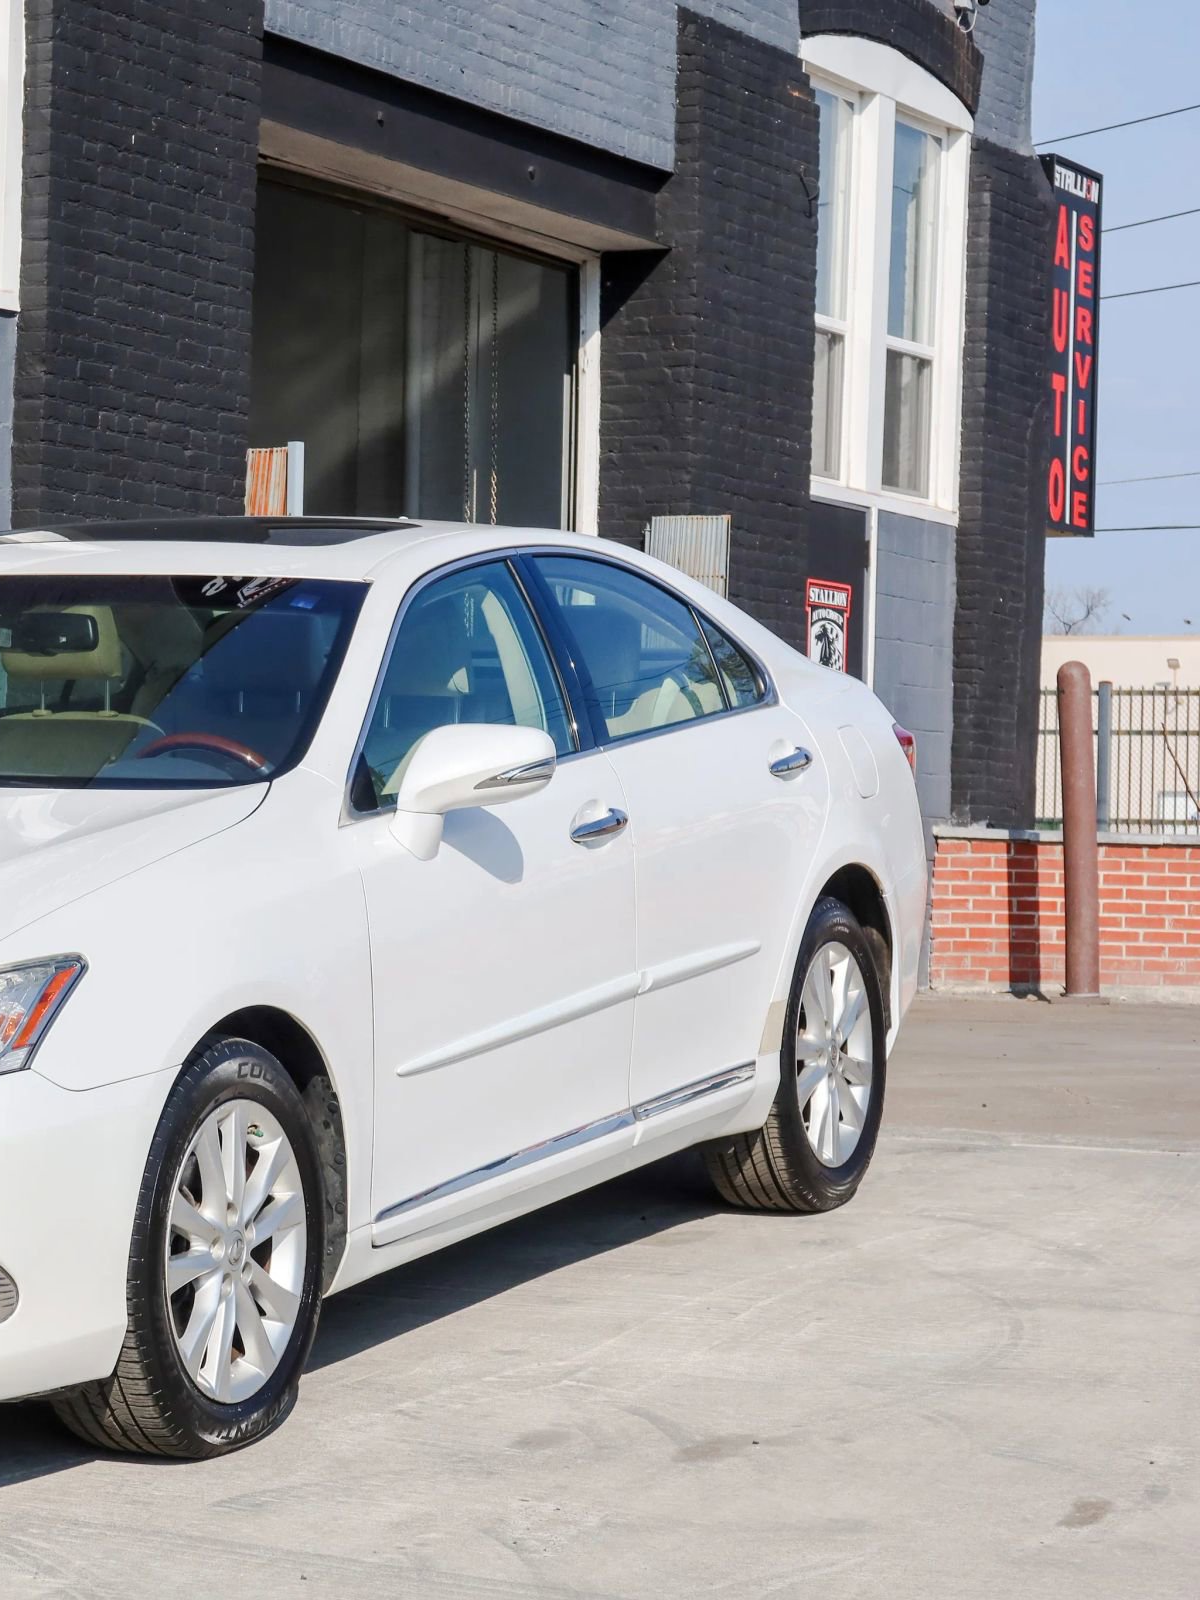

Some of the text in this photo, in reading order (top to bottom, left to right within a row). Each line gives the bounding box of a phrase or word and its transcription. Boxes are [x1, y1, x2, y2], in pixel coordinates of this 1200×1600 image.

[1054, 164, 1100, 204] STALLION
[1048, 204, 1070, 523] AUTO
[1071, 214, 1095, 529] SERVICE
[809, 587, 848, 607] STALLION
